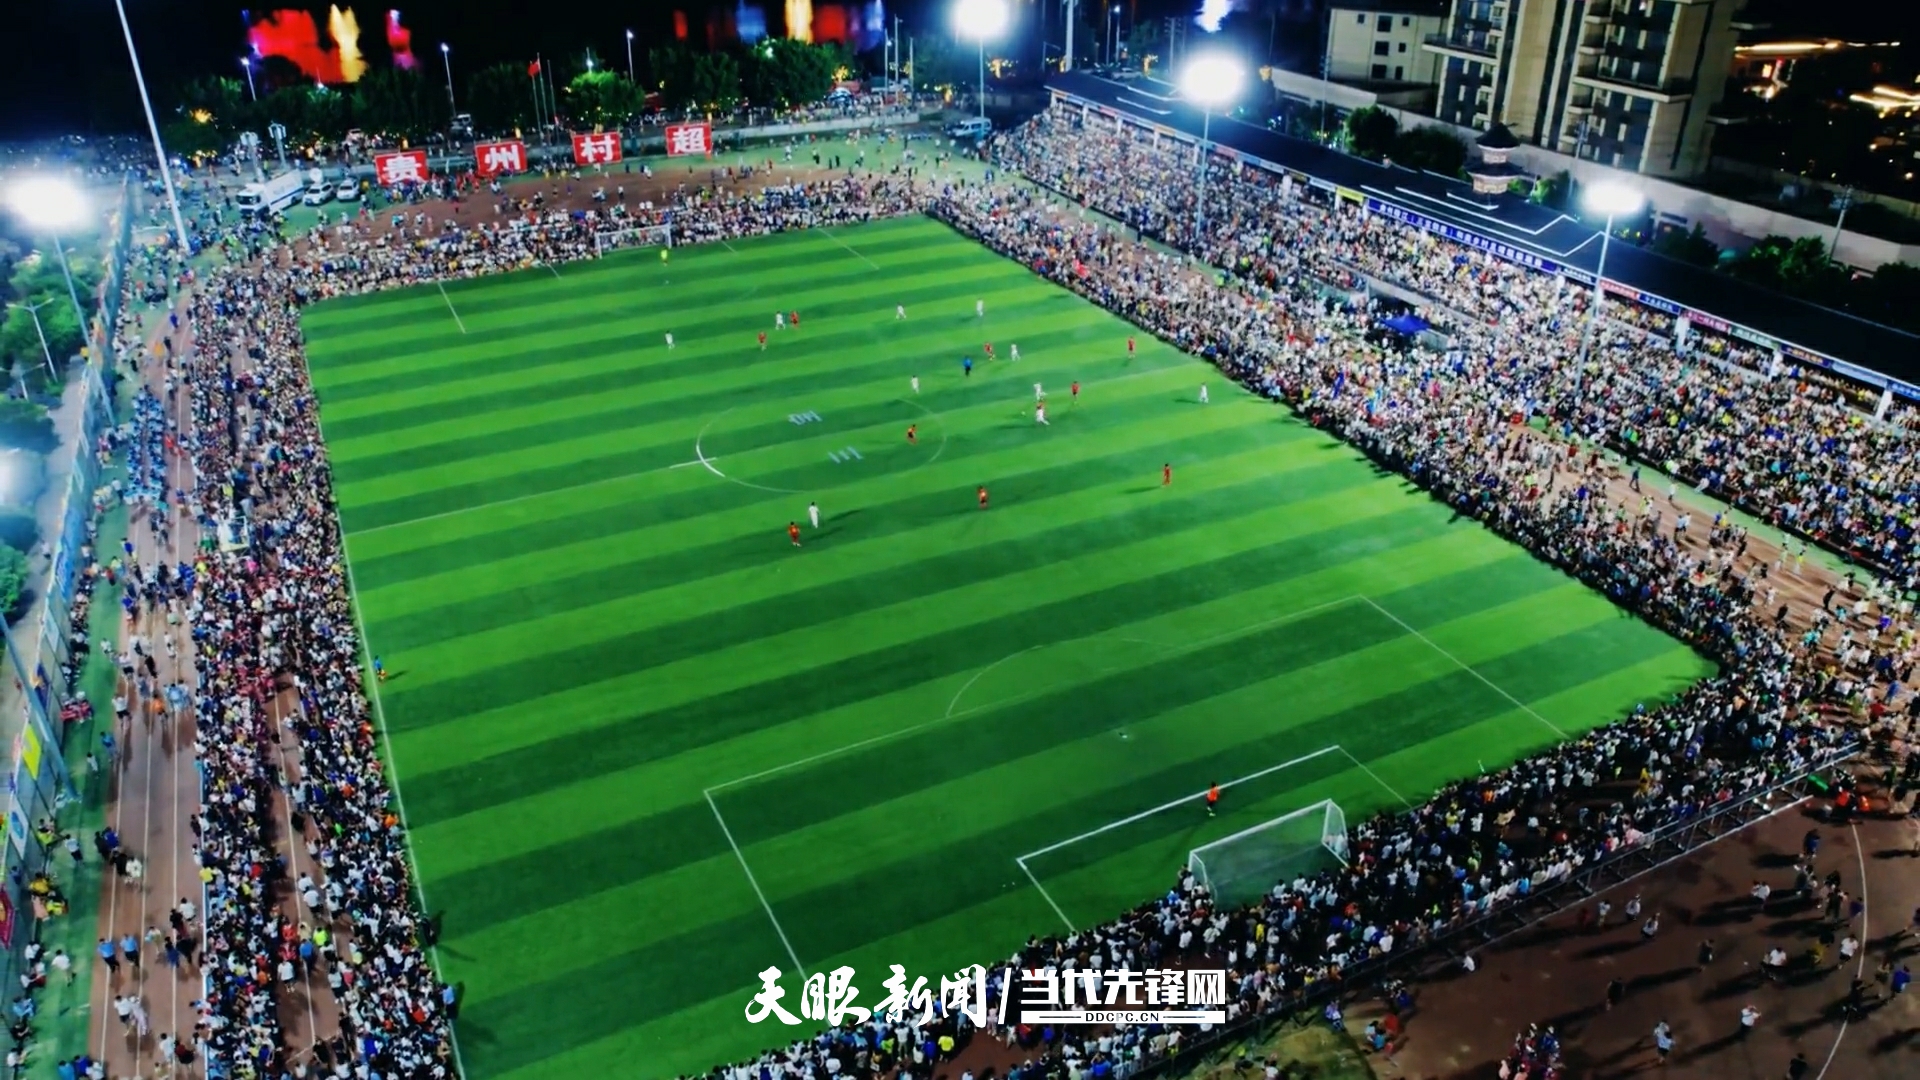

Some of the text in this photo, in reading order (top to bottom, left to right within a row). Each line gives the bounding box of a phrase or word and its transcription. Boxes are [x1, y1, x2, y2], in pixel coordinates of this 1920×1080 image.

[382, 127, 706, 183] 贵 州 村 超
